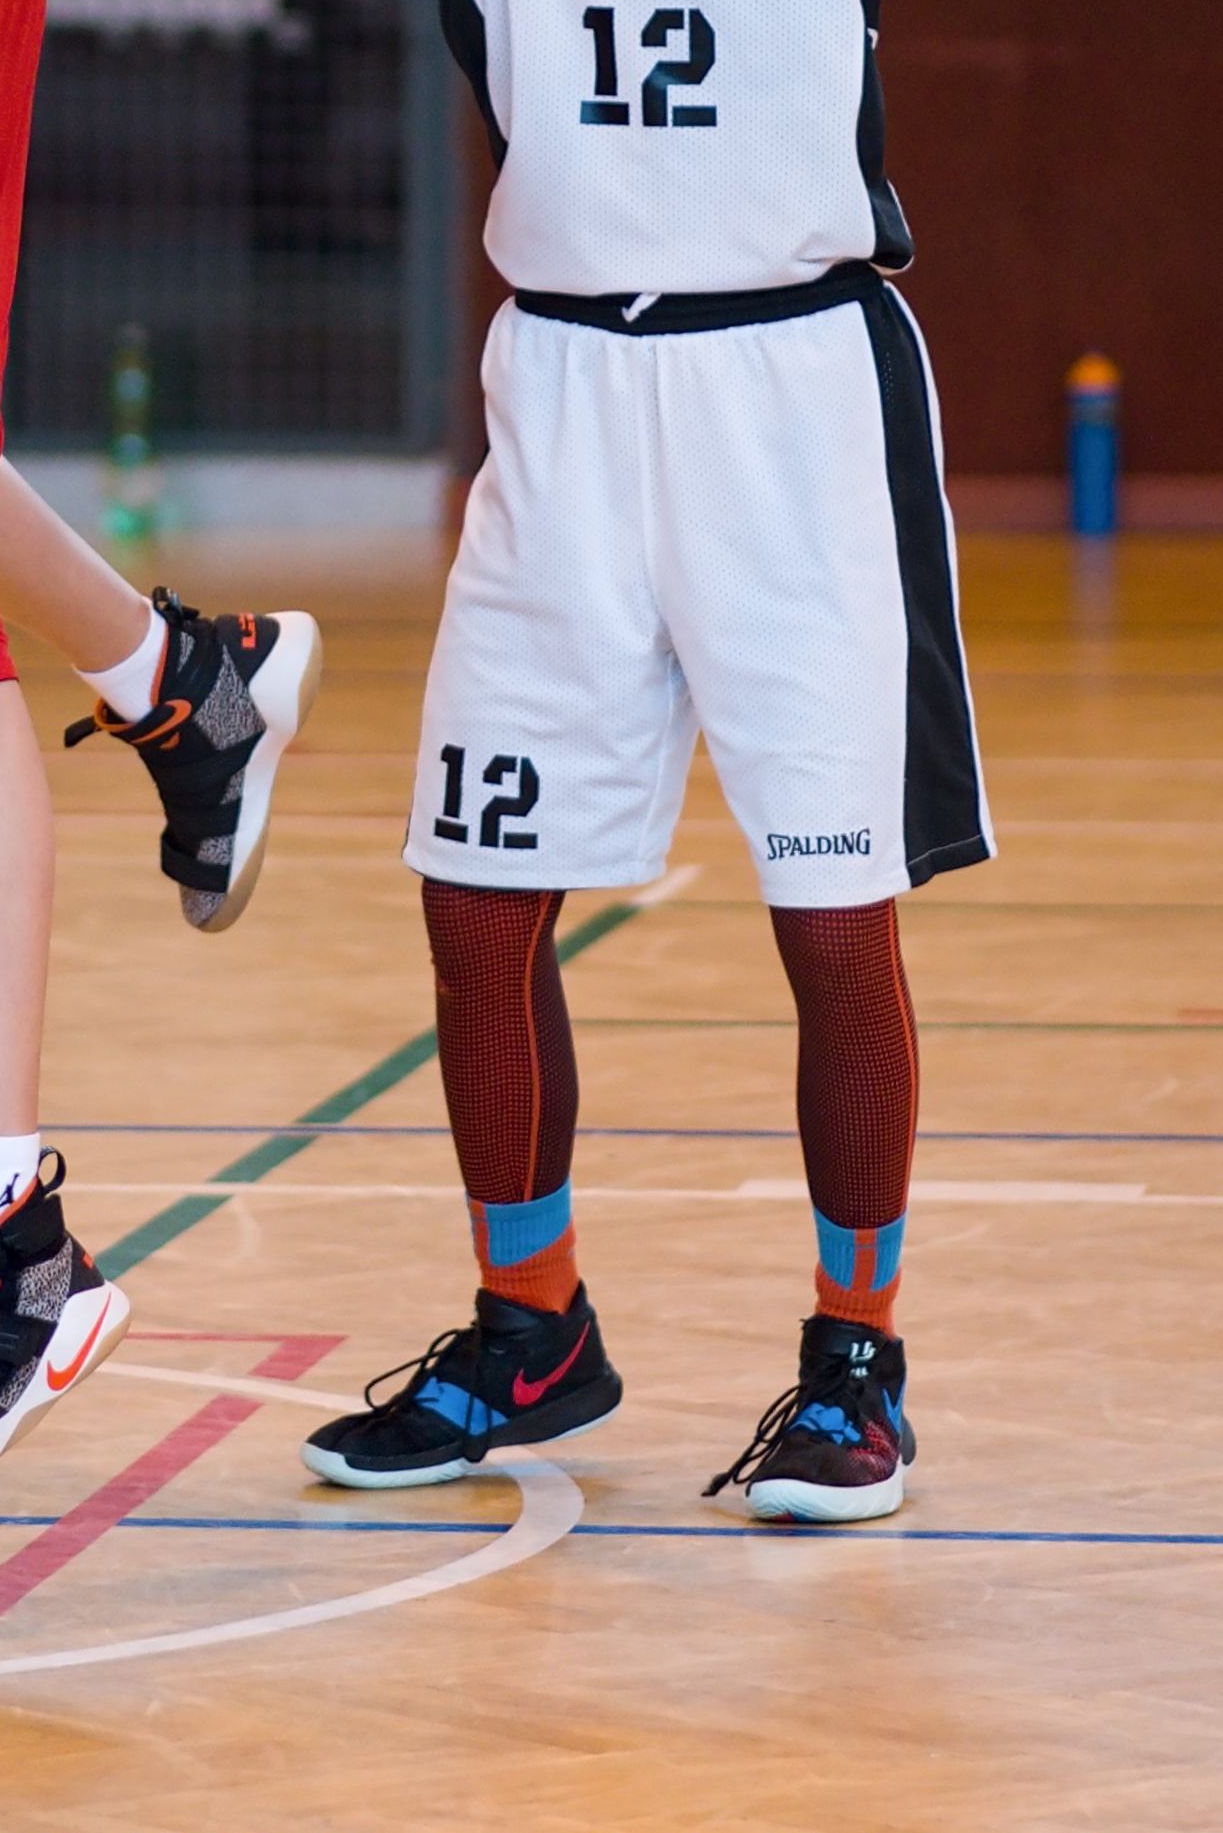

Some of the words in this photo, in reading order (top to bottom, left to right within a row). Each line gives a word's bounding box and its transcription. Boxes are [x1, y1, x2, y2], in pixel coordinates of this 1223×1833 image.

[580, 5, 718, 127] 12
[433, 742, 541, 850] 12
[766, 827, 871, 861] SPALDING
